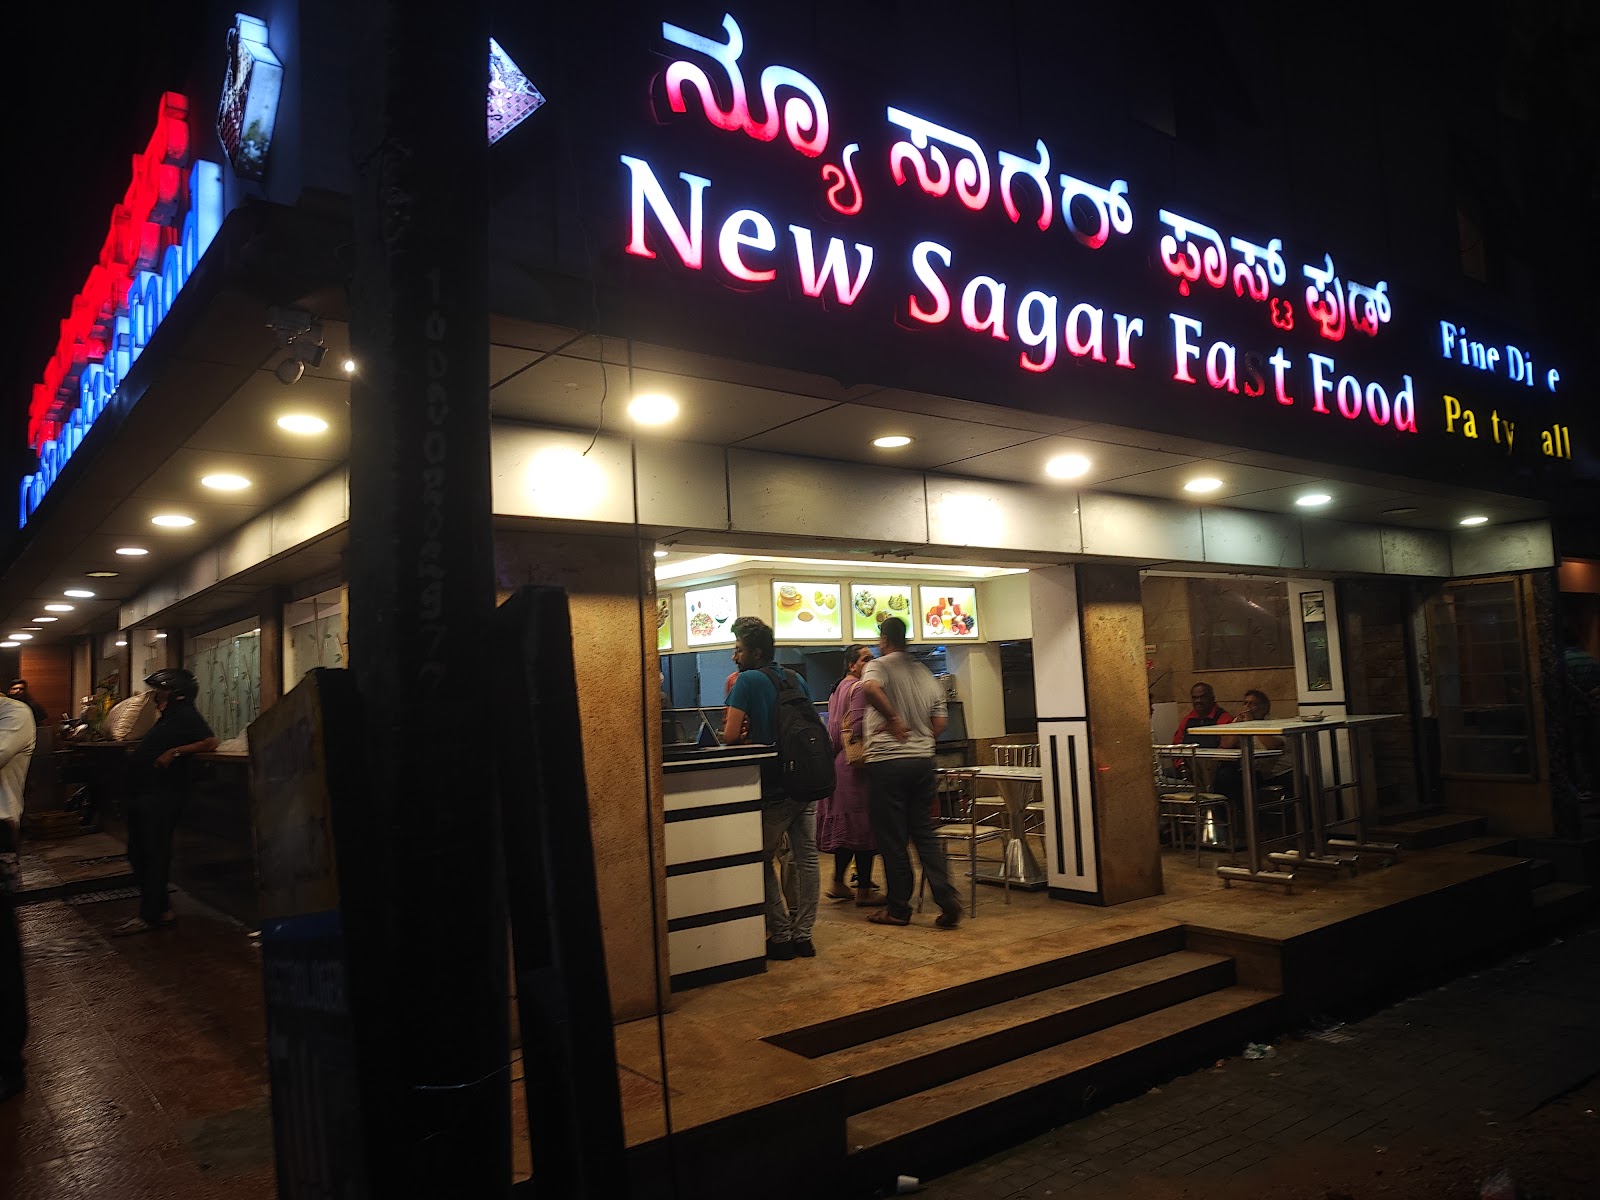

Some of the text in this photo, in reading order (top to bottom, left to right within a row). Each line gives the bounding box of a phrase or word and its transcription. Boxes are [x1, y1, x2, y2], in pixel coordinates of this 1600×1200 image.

[886, 105, 1134, 250] ಸಾಗರ್
[1158, 208, 1295, 331] ಫಾಸ್ಟ್
[620, 154, 1418, 434] New Sagar Fast Food
[1439, 319, 1561, 393] Fine Die
[1442, 394, 1573, 461] Paty all
